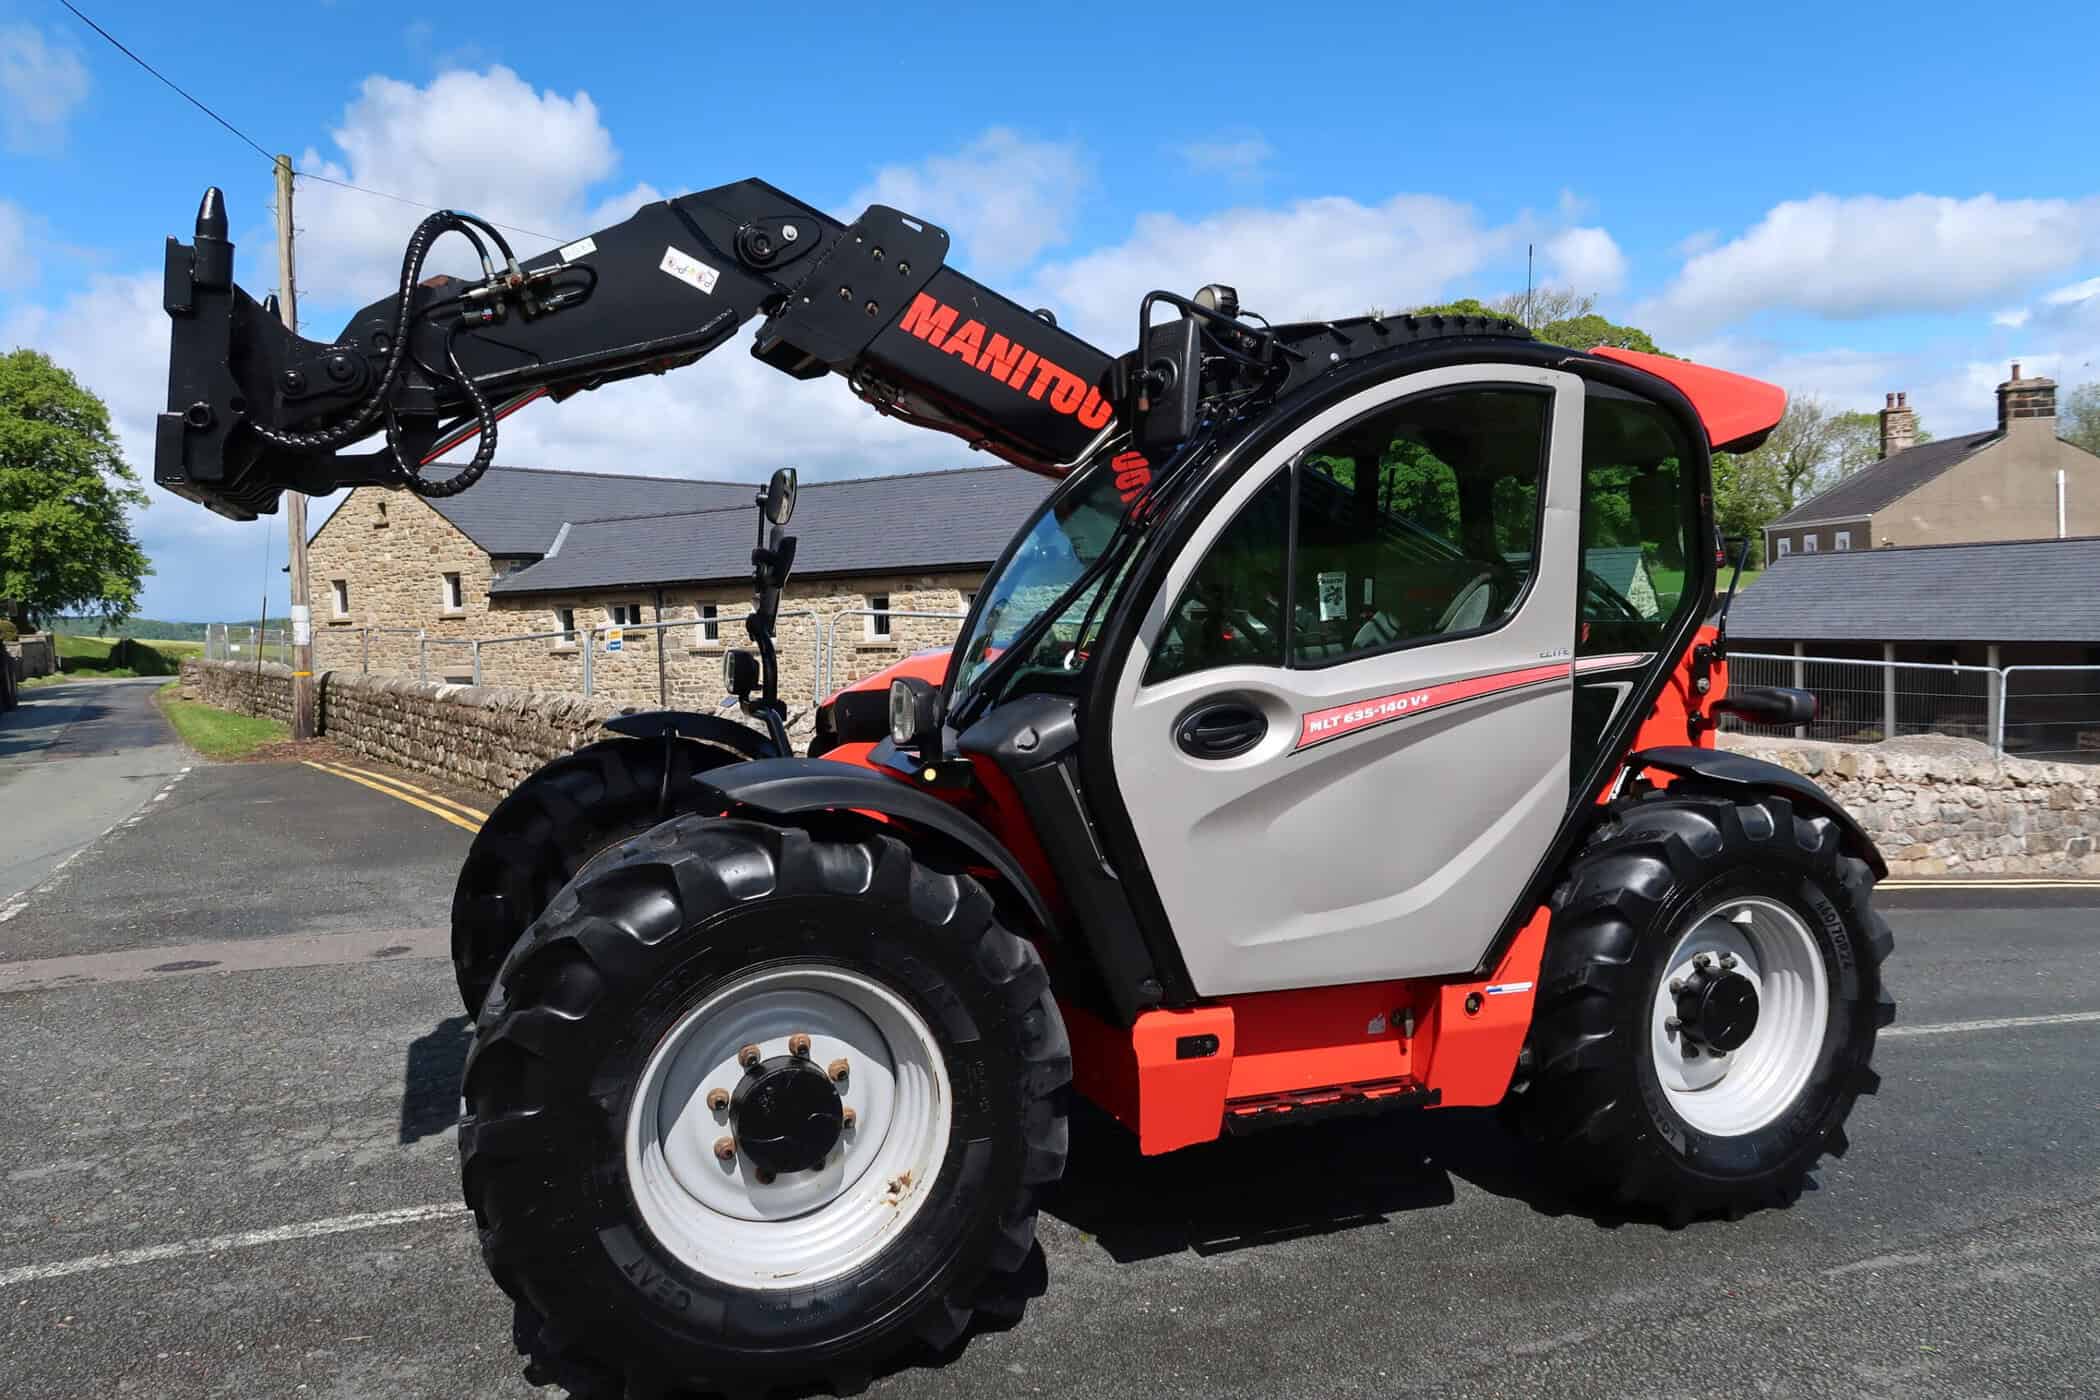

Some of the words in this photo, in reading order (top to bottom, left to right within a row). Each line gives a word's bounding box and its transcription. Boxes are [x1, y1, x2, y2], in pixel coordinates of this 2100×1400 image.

[900, 292, 1113, 430] MANITOU
[1310, 717, 1341, 733] MLT
[1343, 699, 1408, 724] 635-140
